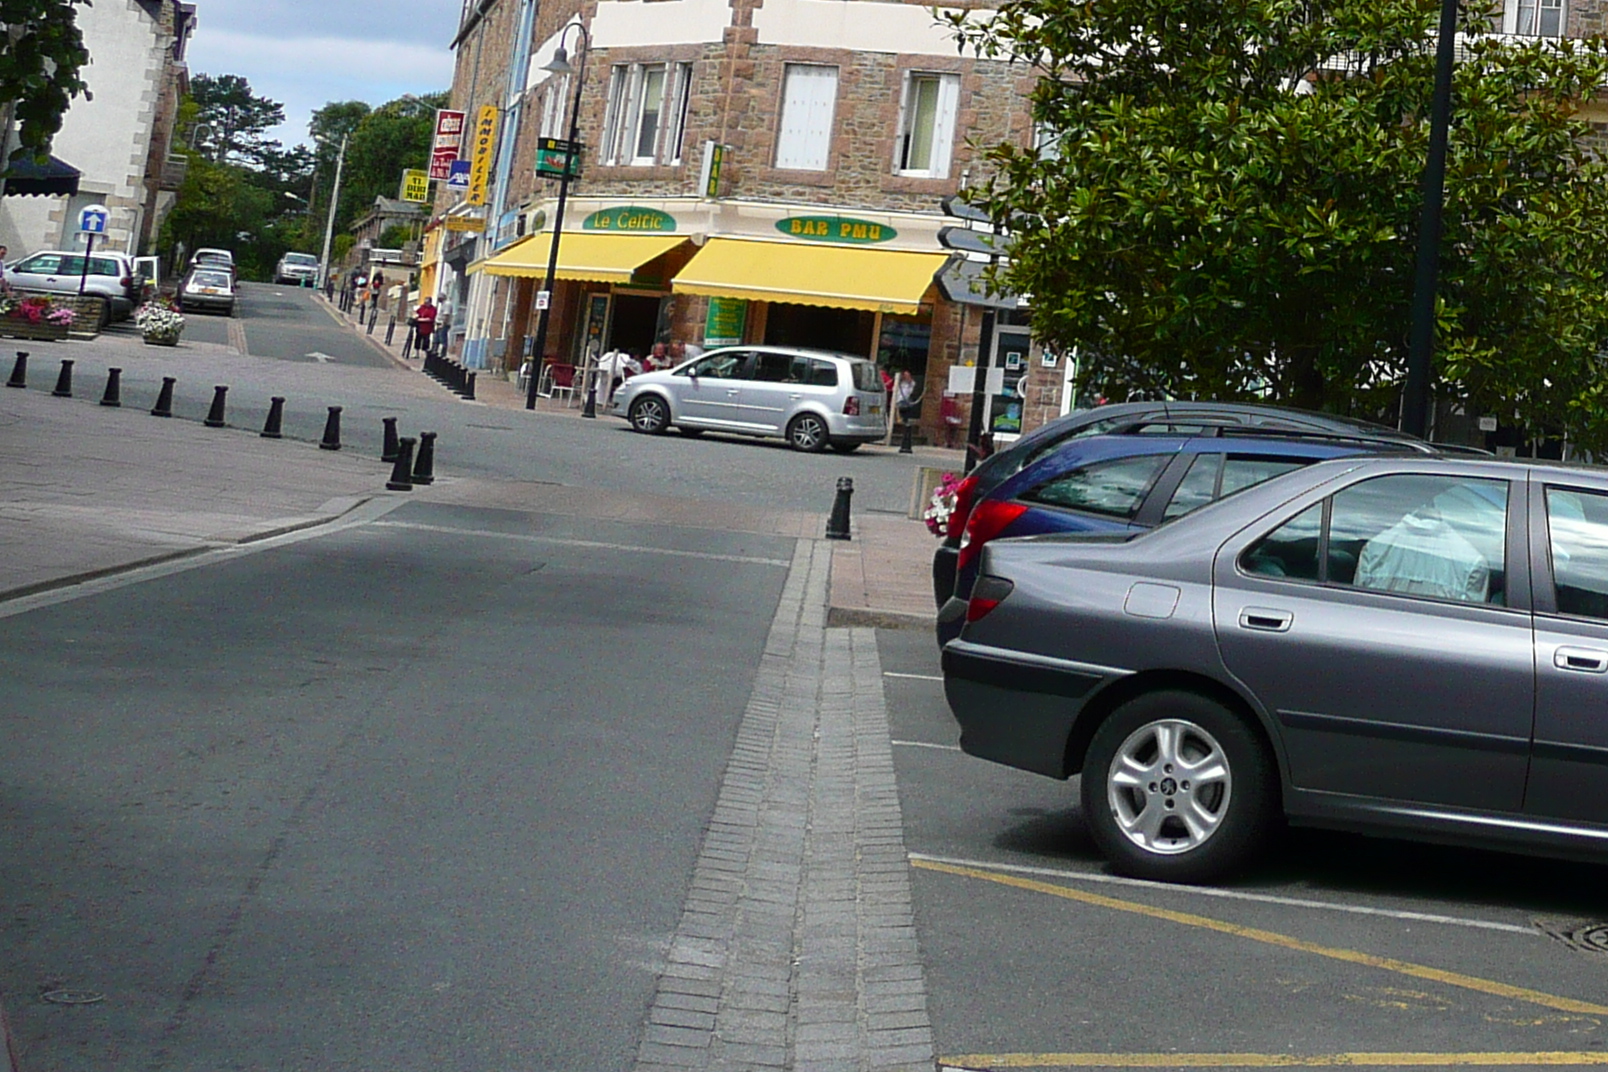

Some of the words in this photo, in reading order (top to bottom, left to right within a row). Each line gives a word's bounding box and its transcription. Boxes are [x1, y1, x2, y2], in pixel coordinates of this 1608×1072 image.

[470, 109, 493, 202] IMMOBILIER
[709, 147, 721, 197] BAR
[594, 215, 611, 228] Le
[617, 213, 663, 229] Celtic
[791, 220, 828, 236] BAR
[840, 223, 880, 240] PMU
